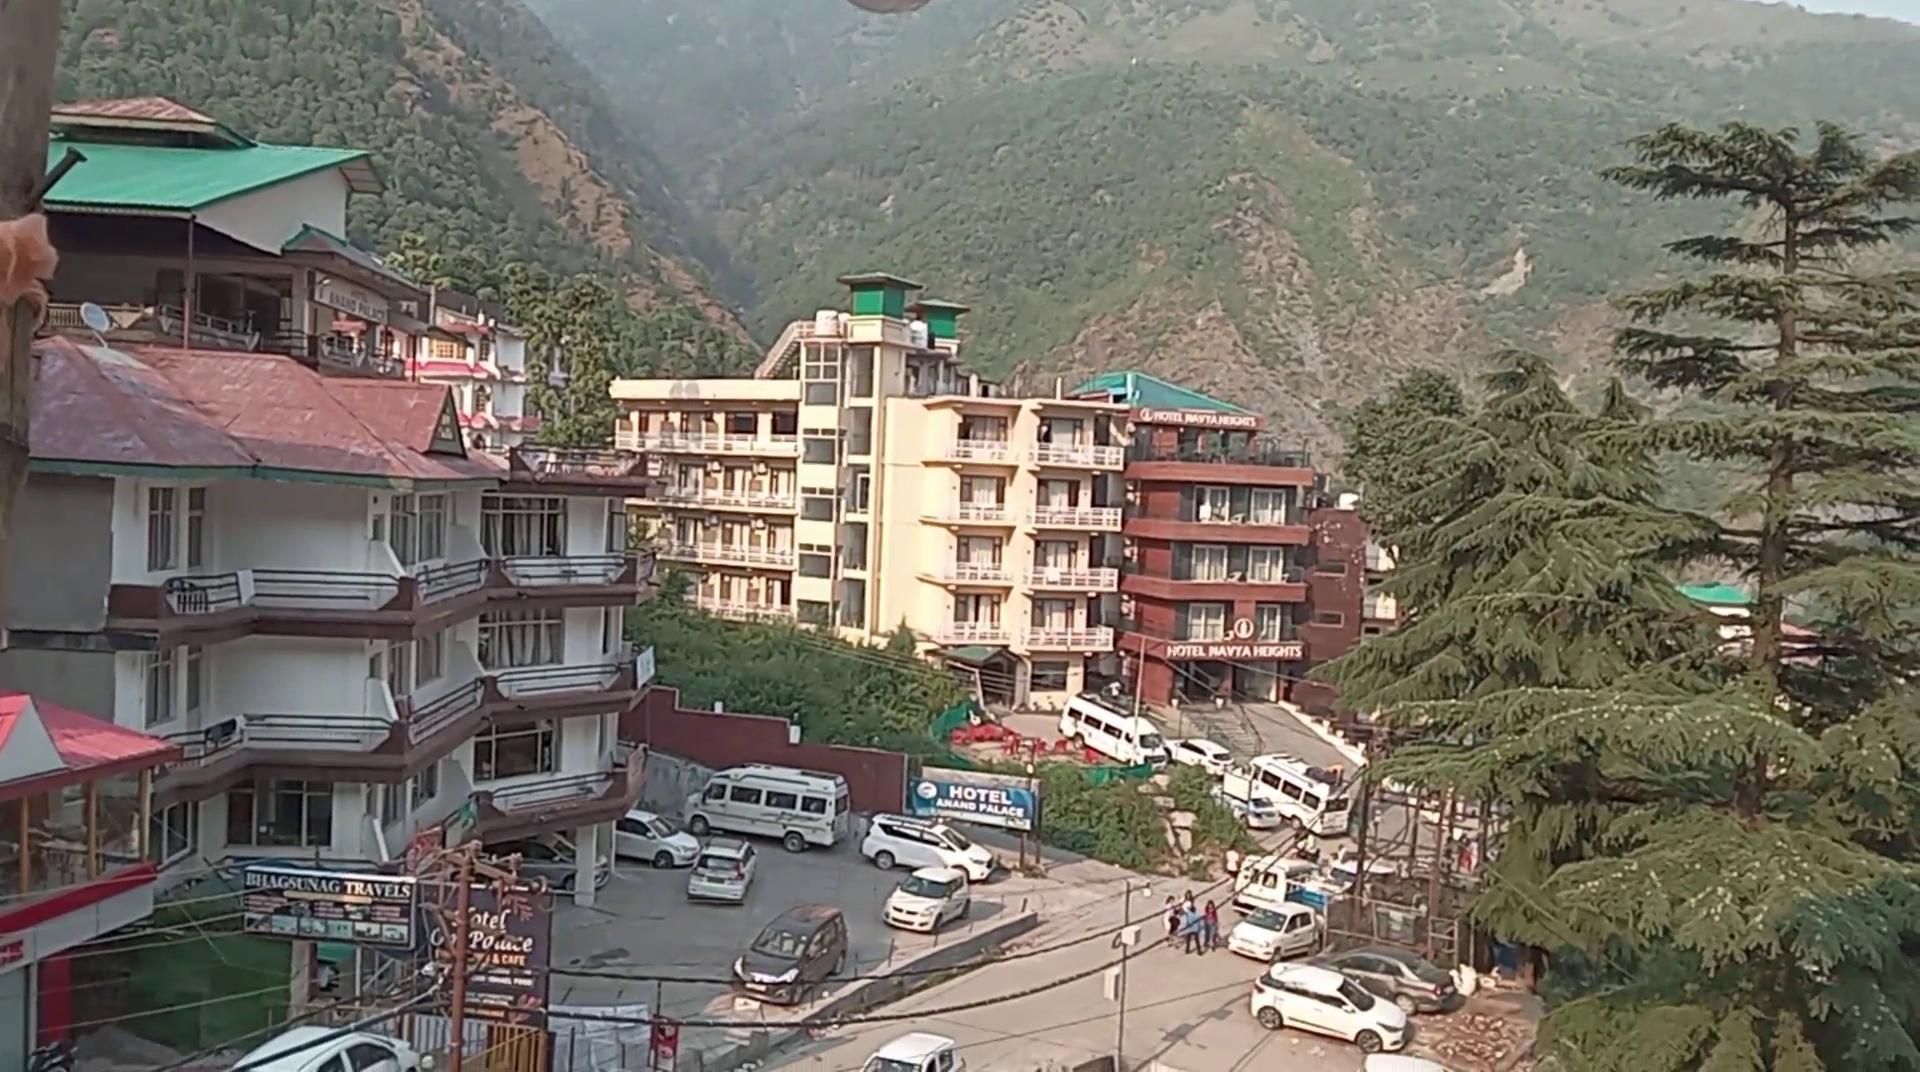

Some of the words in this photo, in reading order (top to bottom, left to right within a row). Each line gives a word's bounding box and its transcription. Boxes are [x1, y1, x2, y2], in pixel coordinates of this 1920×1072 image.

[1153, 411, 1183, 422] HOTEL
[1185, 413, 1217, 424] NAVYA
[1219, 415, 1256, 427] HEIGHTS
[1167, 645, 1206, 657] HOTEL
[1208, 645, 1252, 657] NAVYA
[1253, 645, 1302, 657] HEIGHTS
[949, 785, 1013, 805] HOTEL
[936, 798, 977, 811] ANAND
[979, 803, 1025, 818] PALACE
[246, 872, 341, 893] BHAGSUNAG
[344, 881, 411, 897] TRAVELS
[502, 954, 526, 966] CAFE
